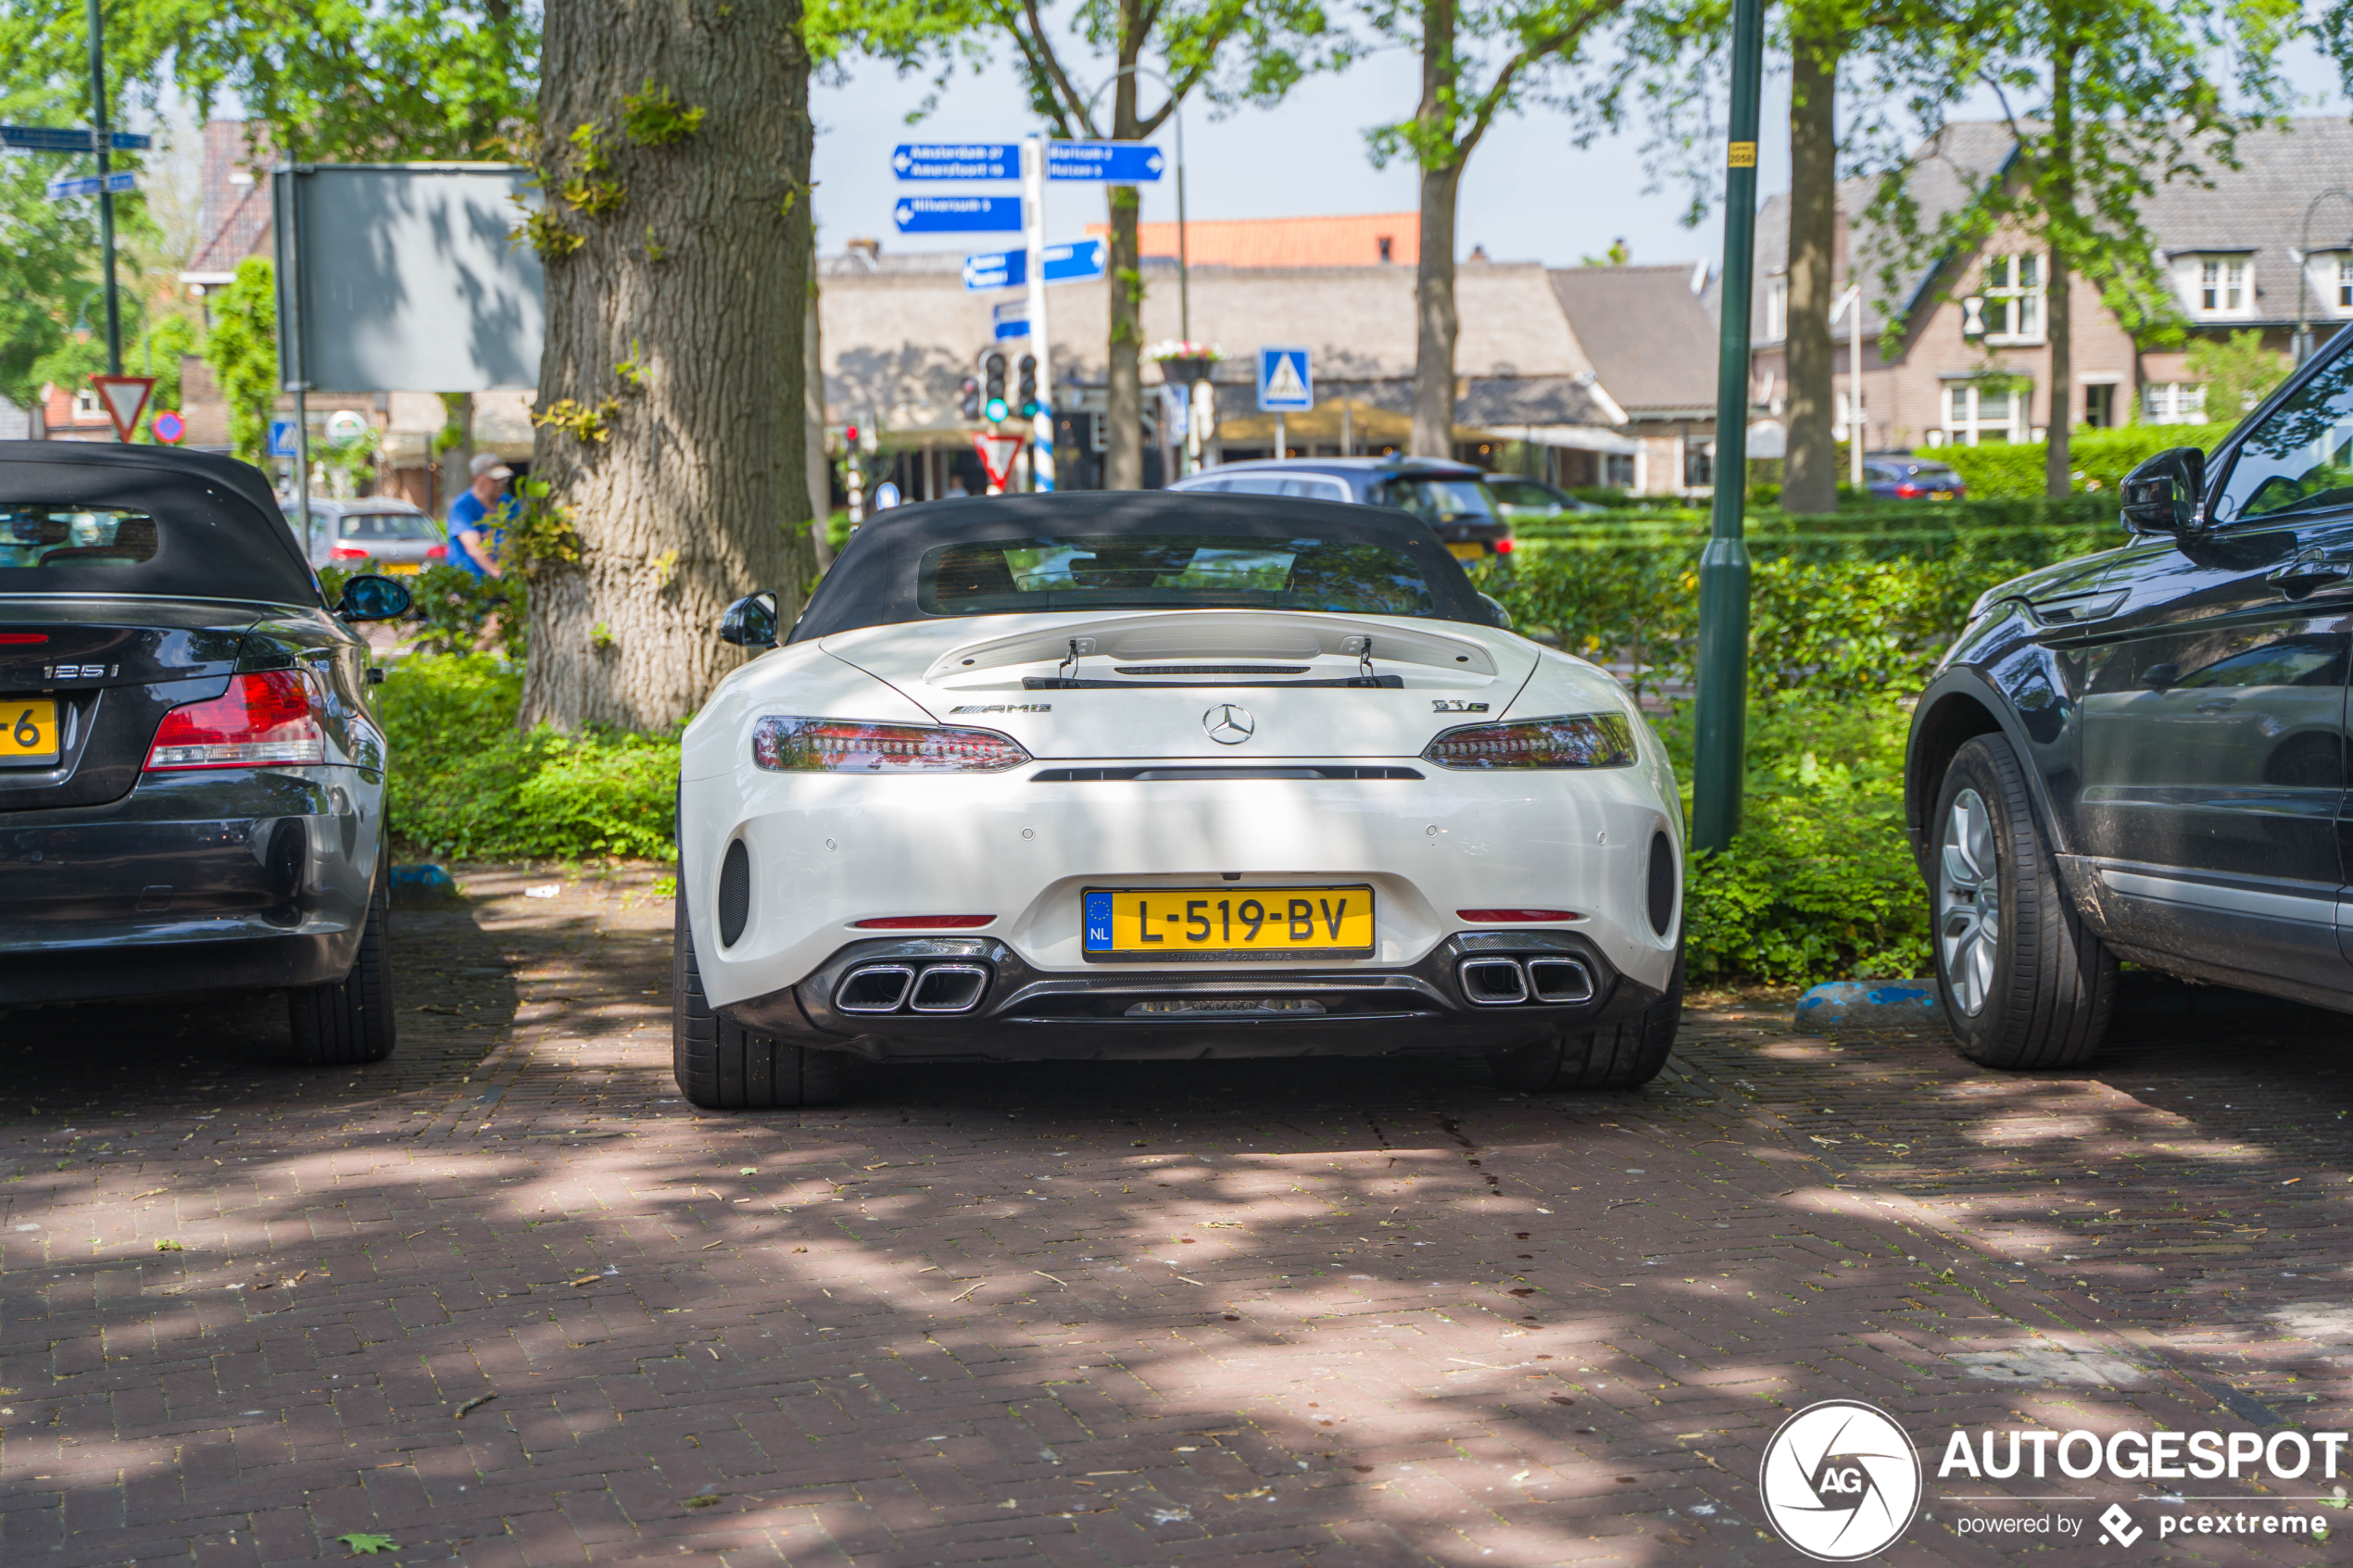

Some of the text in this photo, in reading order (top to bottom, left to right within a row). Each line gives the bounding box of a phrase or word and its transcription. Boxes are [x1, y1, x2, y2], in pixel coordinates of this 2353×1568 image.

[910, 144, 988, 160] Amsterdam
[1049, 146, 1103, 160] Blaricum
[1730, 154, 1753, 164] 2058
[910, 161, 988, 177] Amersfoort
[912, 197, 981, 213] Hilversum
[1139, 898, 1347, 942] L-519-BV
[1090, 928, 1109, 940] NL
[1227, 953, 1291, 961] EXCLUSIVE
